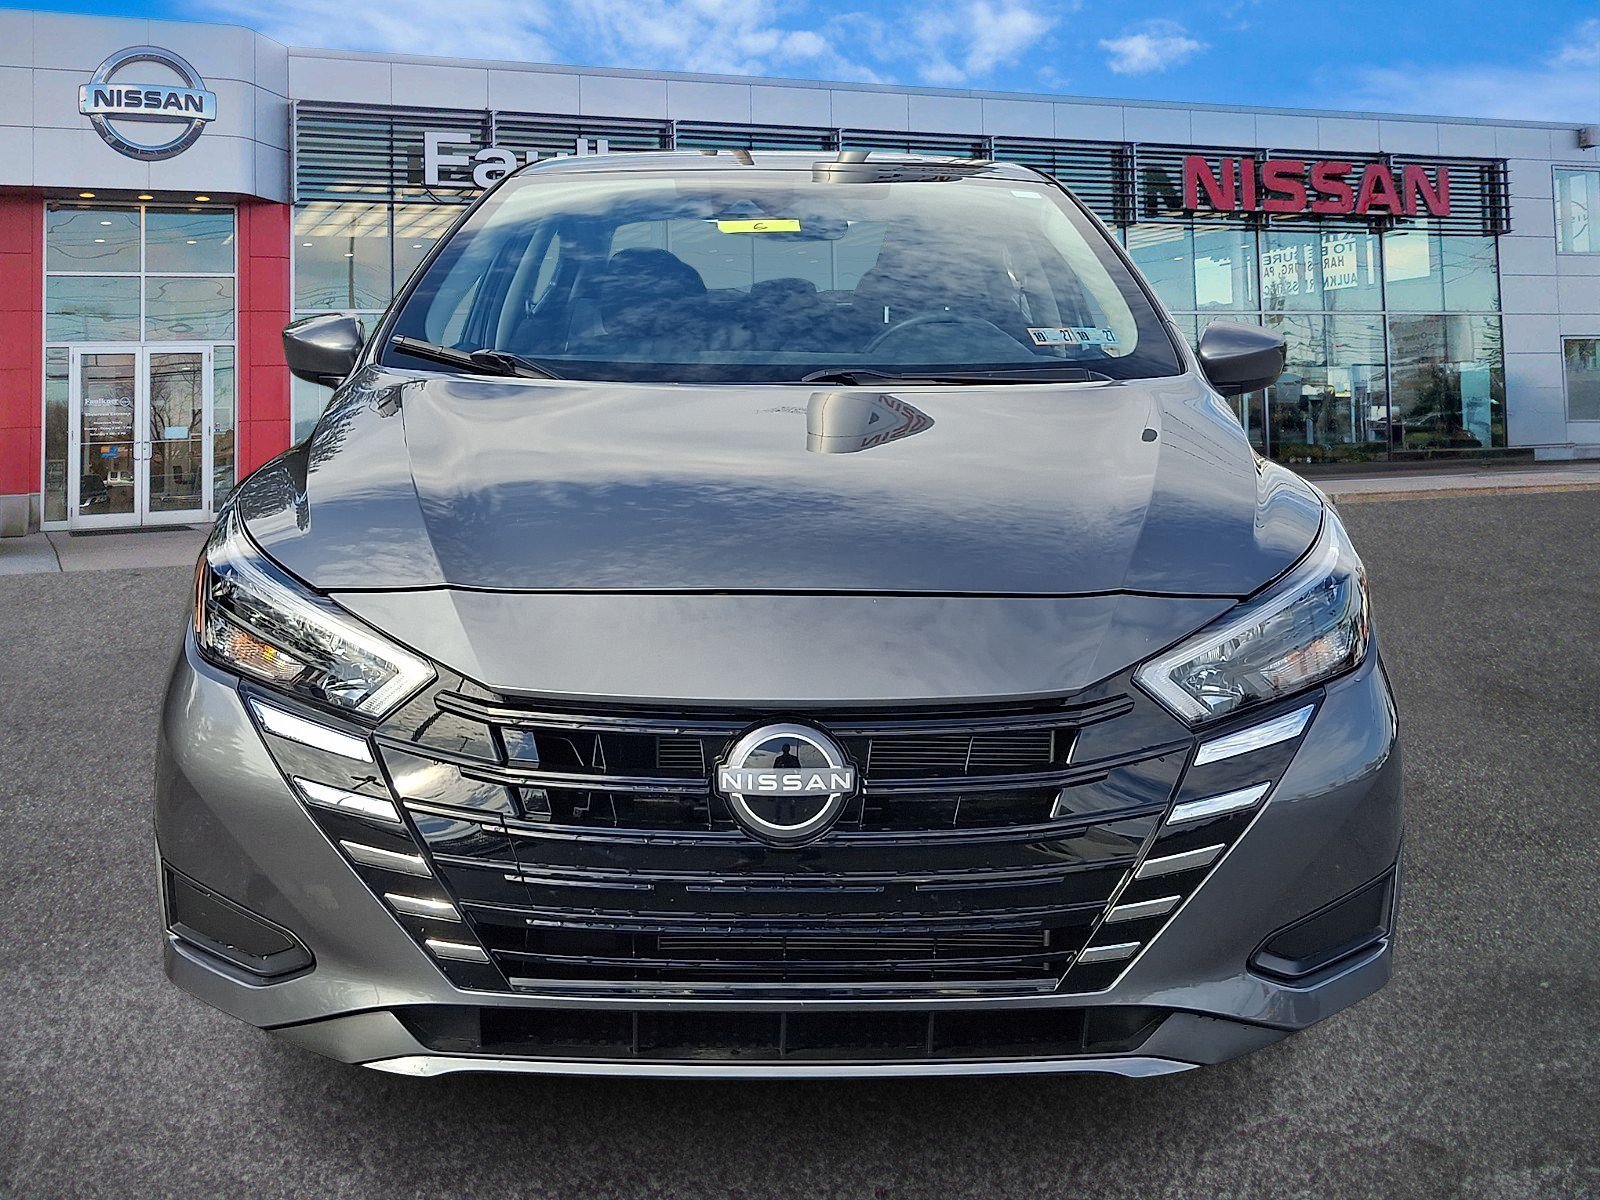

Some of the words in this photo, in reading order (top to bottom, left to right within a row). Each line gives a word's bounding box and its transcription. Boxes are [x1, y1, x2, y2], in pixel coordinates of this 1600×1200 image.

[94, 89, 203, 112] NISSAN
[1182, 155, 1451, 217] NISSAN
[1060, 330, 1073, 342] 27
[1102, 330, 1116, 342] 27
[722, 773, 850, 791] NISSAN
